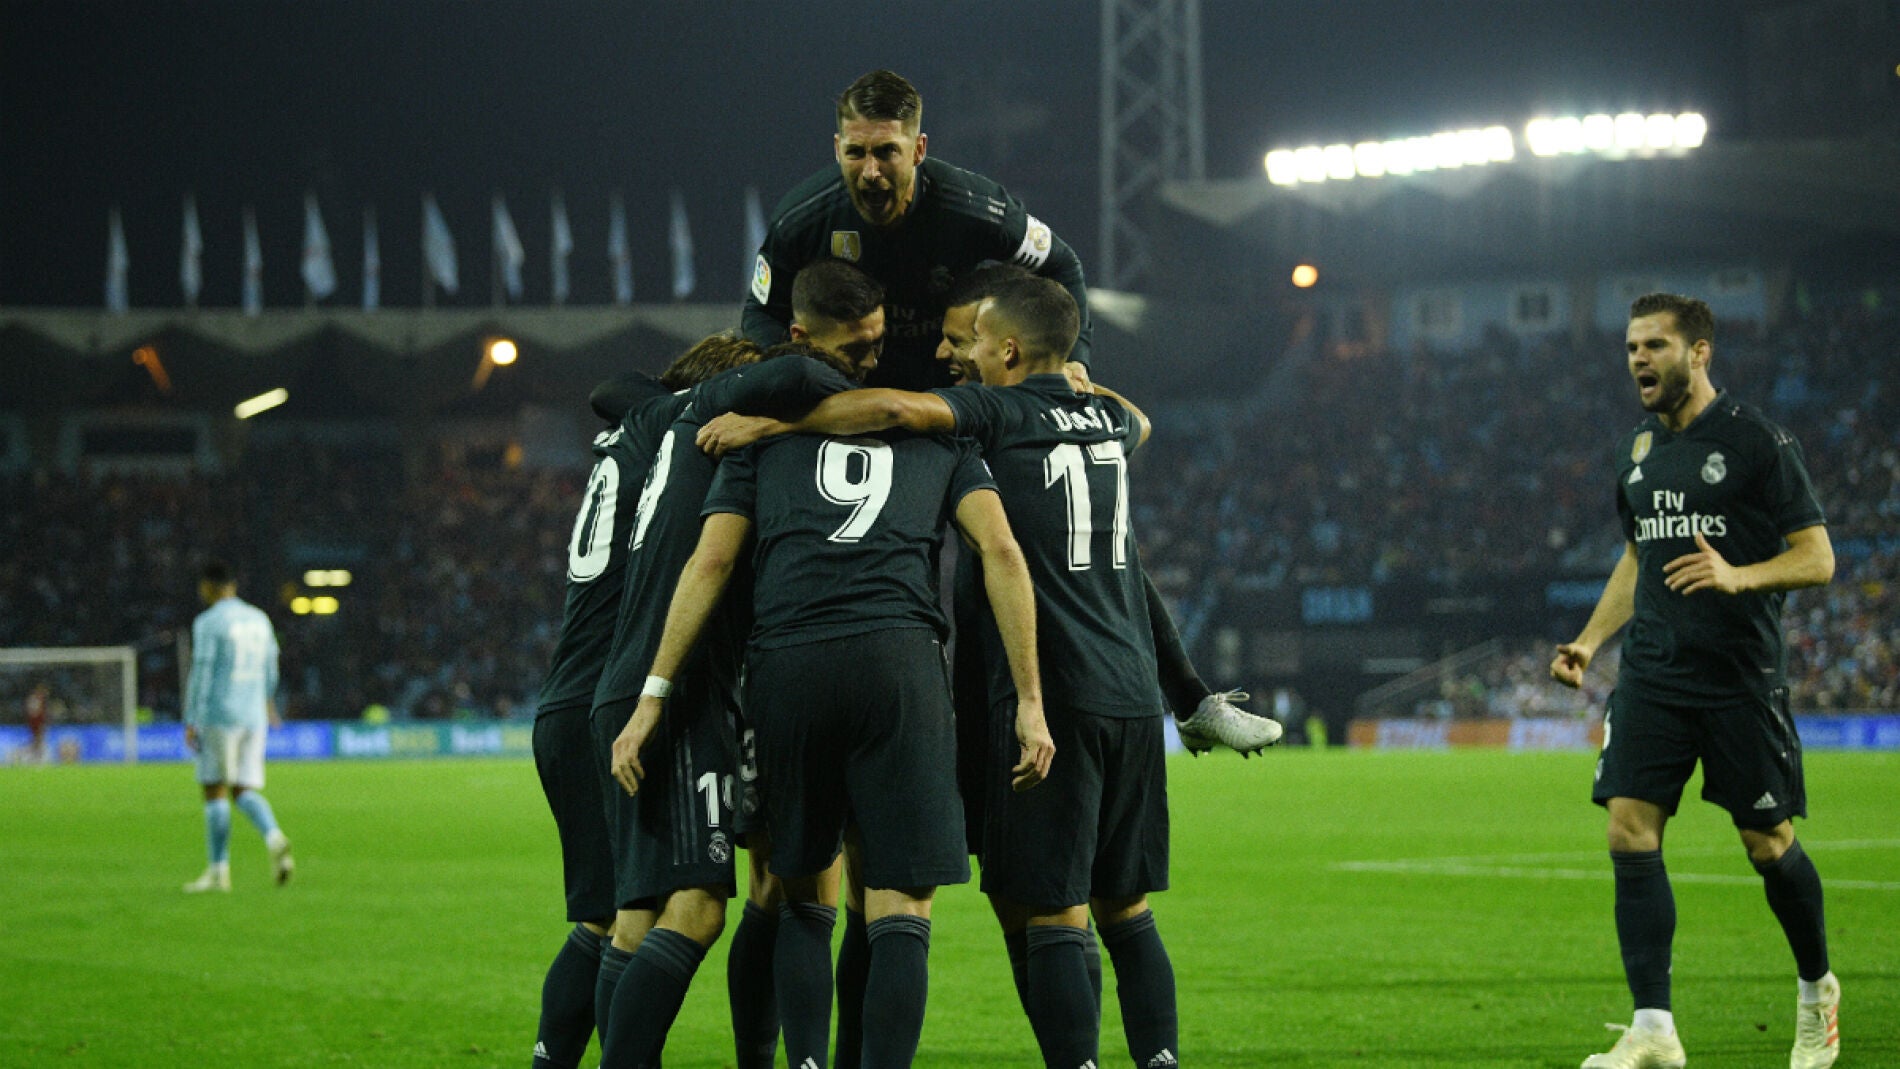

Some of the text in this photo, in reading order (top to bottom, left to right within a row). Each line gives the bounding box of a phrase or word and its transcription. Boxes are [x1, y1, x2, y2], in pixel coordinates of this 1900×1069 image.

[815, 439, 894, 542] 9
[1043, 440, 1128, 571] 17
[1652, 490, 1685, 512] Fly
[1635, 510, 1727, 542] Emirates
